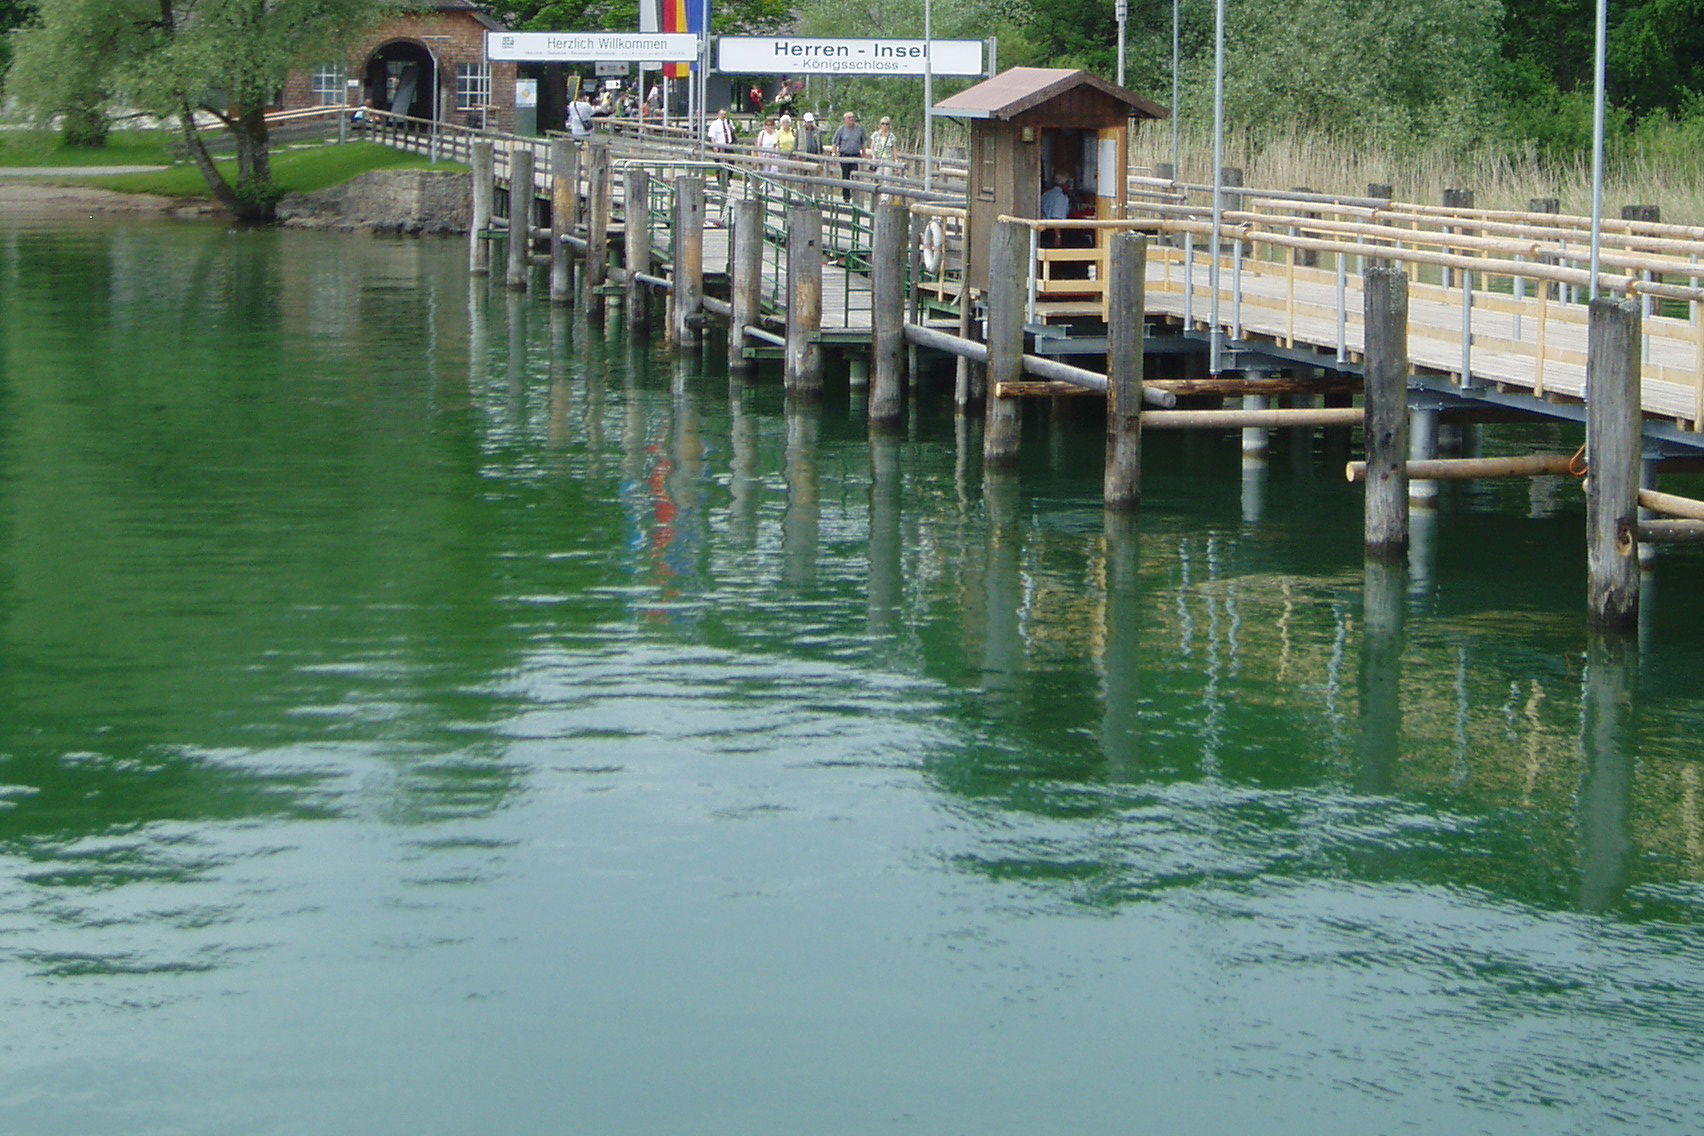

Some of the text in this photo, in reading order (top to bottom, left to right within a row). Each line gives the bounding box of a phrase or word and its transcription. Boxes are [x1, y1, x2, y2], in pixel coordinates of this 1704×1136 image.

[547, 37, 668, 51] Herzlich Willkommen
[774, 42, 849, 57] Herren
[875, 43, 927, 58] Insel
[803, 59, 899, 70] Königsschloss
